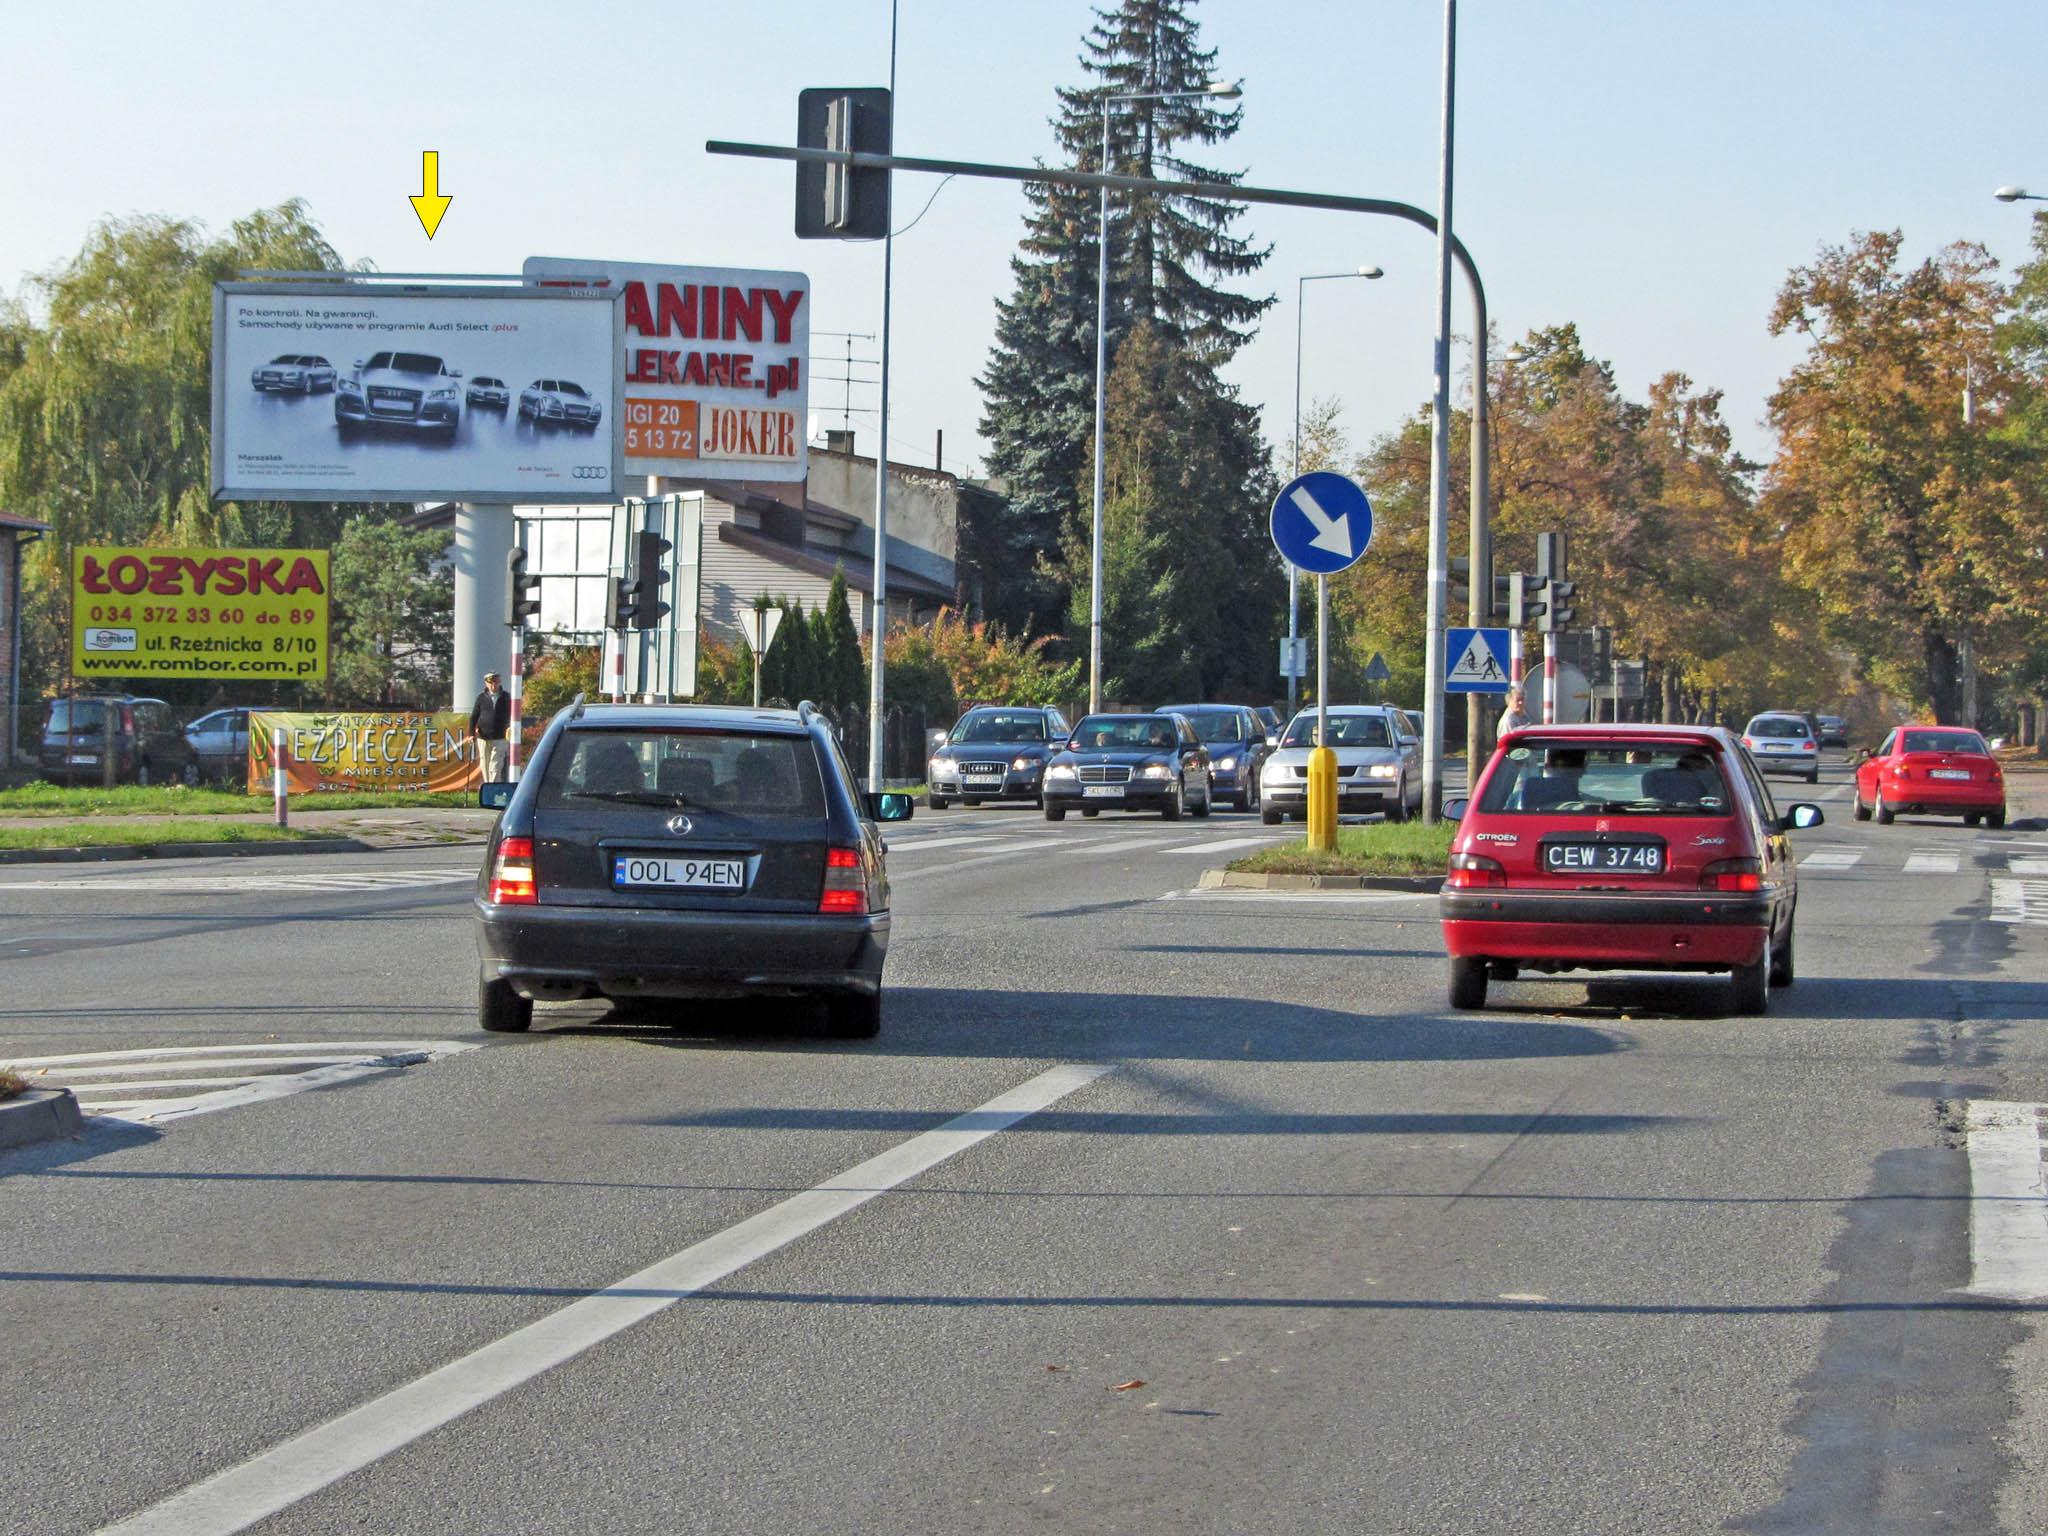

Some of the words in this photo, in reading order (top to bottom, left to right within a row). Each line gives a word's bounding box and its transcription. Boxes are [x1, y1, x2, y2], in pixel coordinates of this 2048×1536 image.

[239, 308, 253, 317] Po
[306, 309, 319, 318] Na
[538, 280, 804, 343] ANINY
[239, 320, 302, 330] Samochody
[368, 321, 425, 332] programie
[428, 322, 453, 332] Audi
[456, 323, 488, 332] Select
[659, 405, 679, 425] 20
[645, 431, 664, 450] 13
[671, 431, 692, 450] 72
[704, 408, 797, 457] JOKER
[143, 607, 178, 624] 372
[186, 607, 212, 624] 33
[219, 608, 245, 624] 60
[255, 611, 281, 625] do
[289, 608, 316, 625] 89
[145, 637, 166, 651] ul.
[273, 637, 317, 653] 8/10
[83, 657, 318, 676] www.rombor.com.pl
[1549, 846, 1594, 866] CEW
[1606, 847, 1658, 866] 3748
[629, 860, 676, 882] OOL
[685, 862, 741, 885] 94EN
